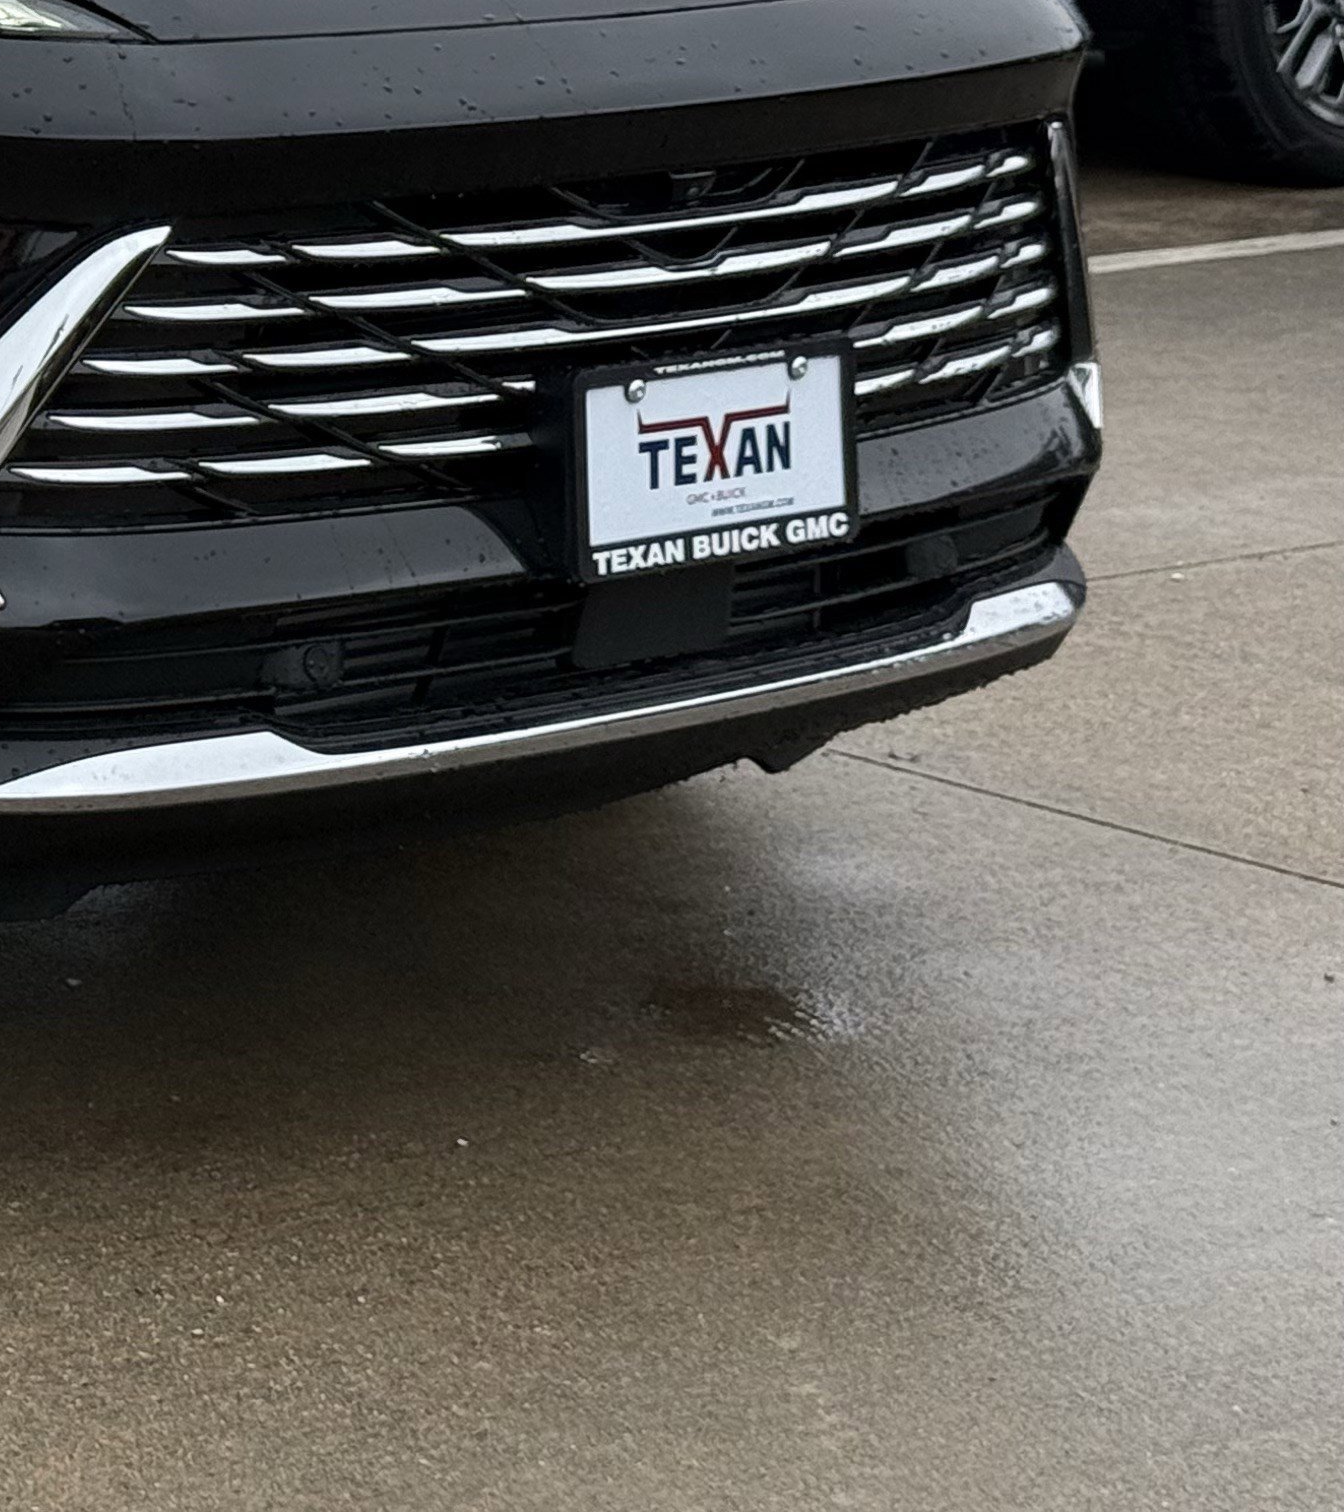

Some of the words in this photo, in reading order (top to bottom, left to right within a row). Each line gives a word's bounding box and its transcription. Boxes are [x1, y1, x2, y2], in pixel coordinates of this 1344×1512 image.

[637, 410, 792, 491] TEXAN
[592, 538, 685, 576] TEXAN
[692, 523, 781, 560] BUICK
[785, 512, 849, 544] GMC
